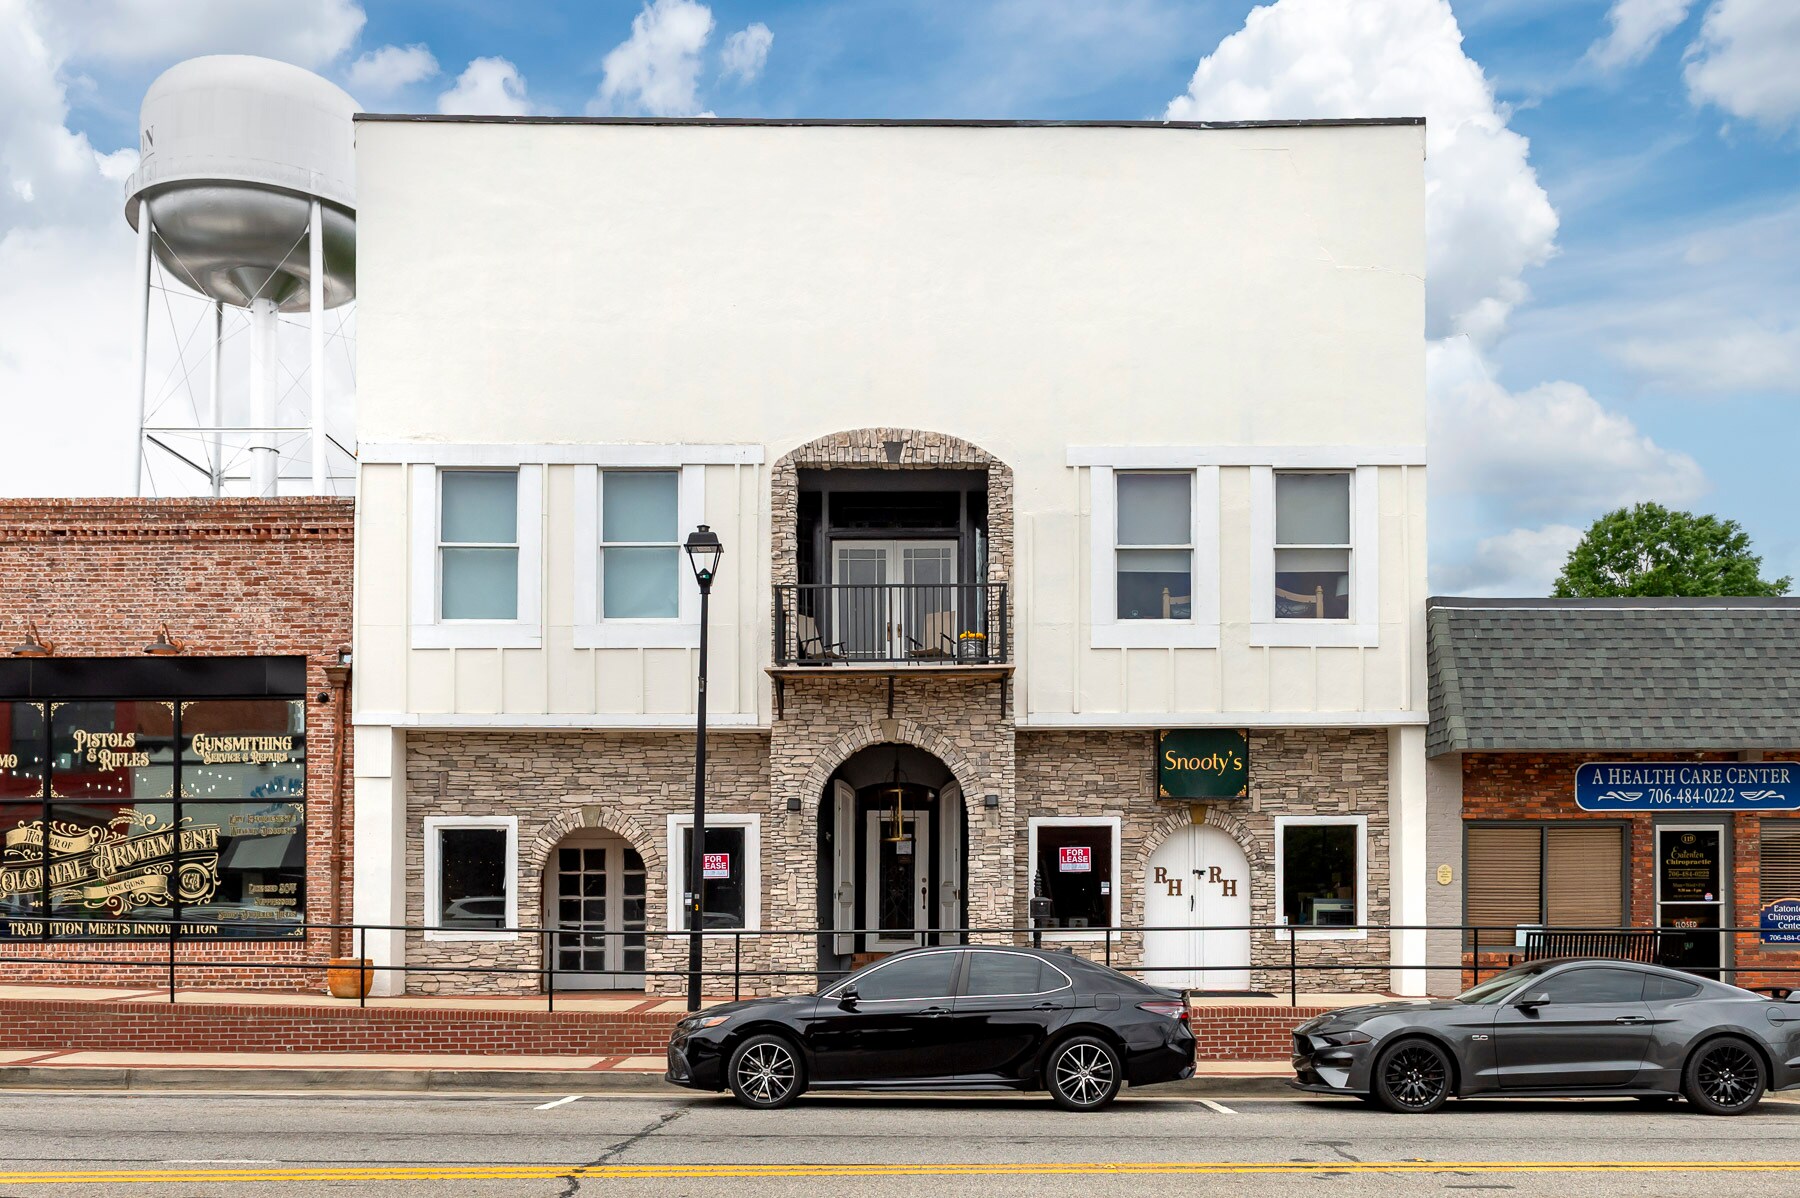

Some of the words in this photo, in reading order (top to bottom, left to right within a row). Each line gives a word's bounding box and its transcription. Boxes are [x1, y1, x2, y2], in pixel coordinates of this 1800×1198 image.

[73, 729, 135, 754] PISTOLS
[192, 733, 293, 758] GUNSMITHING
[86, 748, 97, 763] &
[98, 749, 150, 772] RIFLES
[203, 750, 240, 765] SERVICE
[250, 750, 288, 764] REPAIRS
[1165, 750, 1243, 776] Snooty's
[1592, 769, 1604, 785] A
[1608, 768, 1675, 785] HEALTH
[1680, 767, 1722, 784] CARE
[1726, 767, 1791, 784] CENTER
[1648, 788, 1735, 804] 706-484-0222
[24, 830, 60, 847] MAER
[61, 841, 74, 850] OF
[91, 828, 221, 880] ARMAMENT
[104, 885, 123, 895] FINE
[124, 879, 146, 891] GUNS
[88, 922, 131, 935] MEETS
